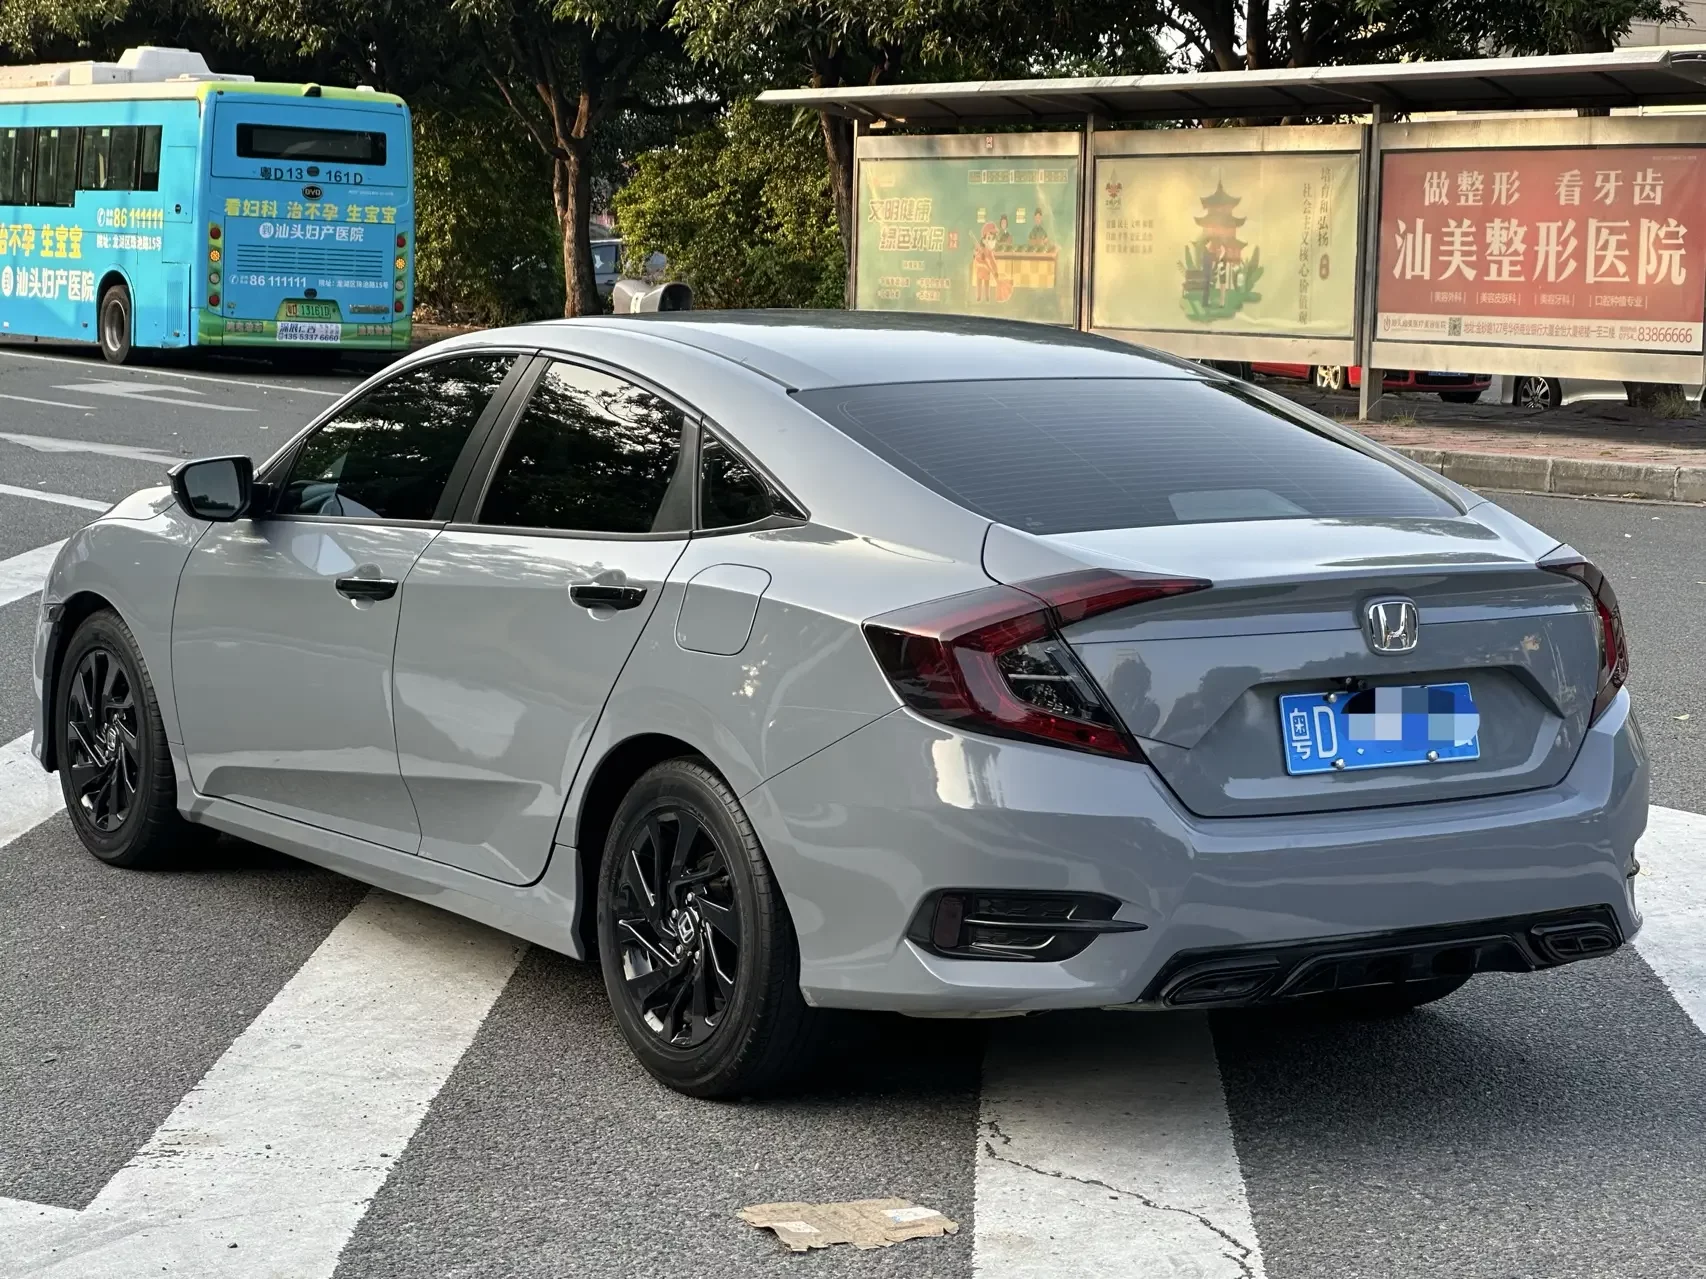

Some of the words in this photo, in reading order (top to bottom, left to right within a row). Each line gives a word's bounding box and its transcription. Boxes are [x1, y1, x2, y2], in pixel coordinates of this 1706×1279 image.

[325, 170, 363, 185] 161D
[1423, 170, 1521, 207] 做整形
[1555, 168, 1665, 206] 看牙齿
[224, 198, 278, 218] 看妇科
[287, 201, 339, 221] 治不孕
[346, 204, 397, 224] 生宝宝
[868, 197, 932, 223] 文明健康
[40, 223, 83, 259] 生宝宝
[274, 223, 365, 243] 汕头妇产医院
[879, 226, 945, 252] 绿色环保
[1393, 217, 1688, 285] 汕美整形医院
[16, 266, 95, 302] 汕头妇产医院
[1637, 326, 1693, 343] 83866666
